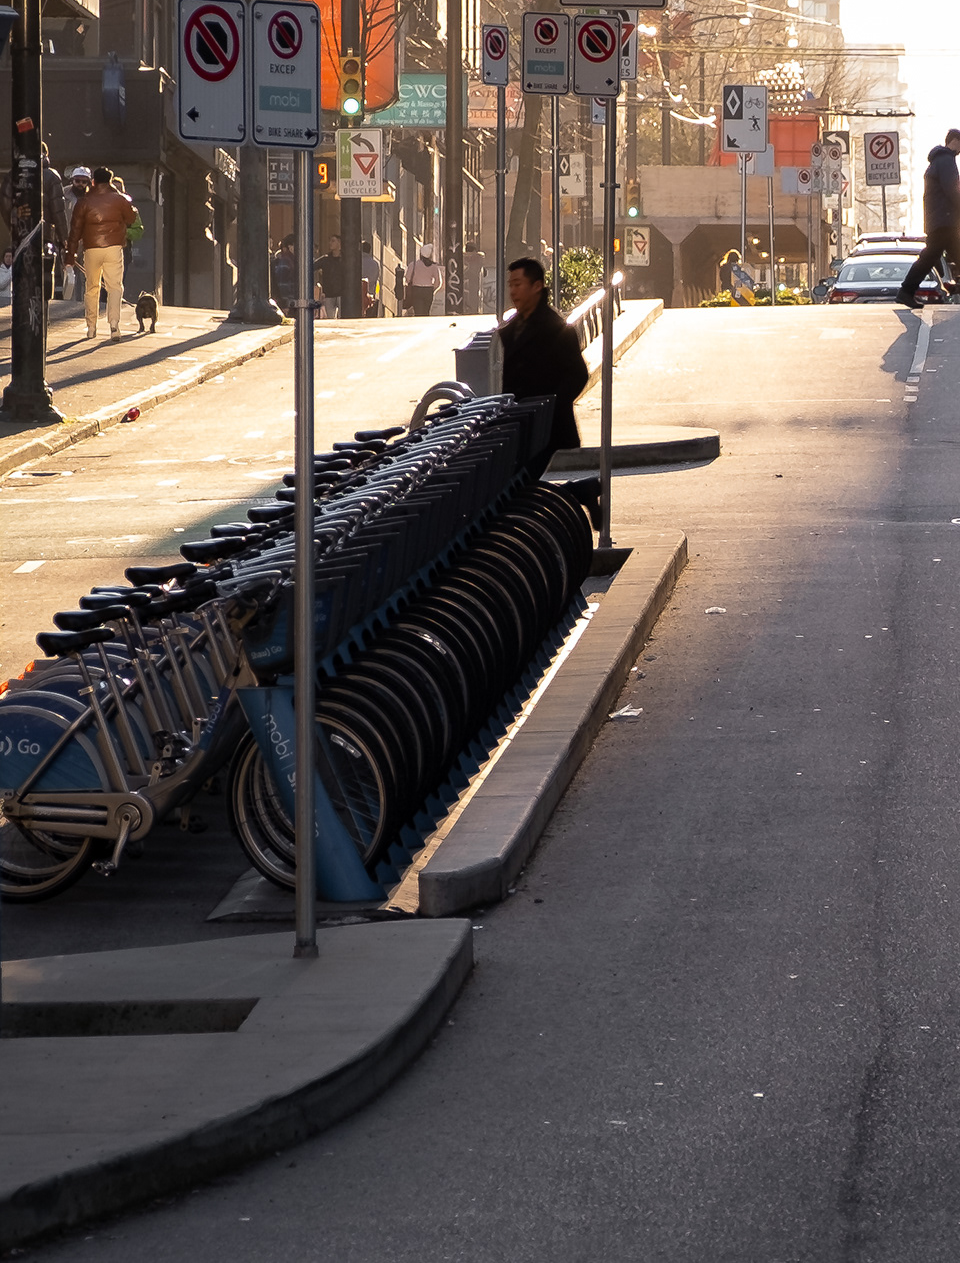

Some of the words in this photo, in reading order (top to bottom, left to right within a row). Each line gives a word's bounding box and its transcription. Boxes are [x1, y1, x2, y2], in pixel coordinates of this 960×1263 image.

[534, 47, 557, 55] EXCEPT
[534, 63, 556, 73] mobi
[269, 90, 301, 108] mobi
[268, 126, 282, 137] BIKE
[283, 127, 304, 138] SHARE
[270, 162, 294, 171] TH
[870, 161, 895, 171] EXCEPT
[317, 162, 329, 184] 9
[867, 171, 899, 181] BICYCLES
[343, 179, 365, 187] YIELD
[270, 645, 283, 654] Go
[206, 702, 223, 733] mobi
[261, 713, 294, 760] mobi
[17, 738, 41, 755] Go
